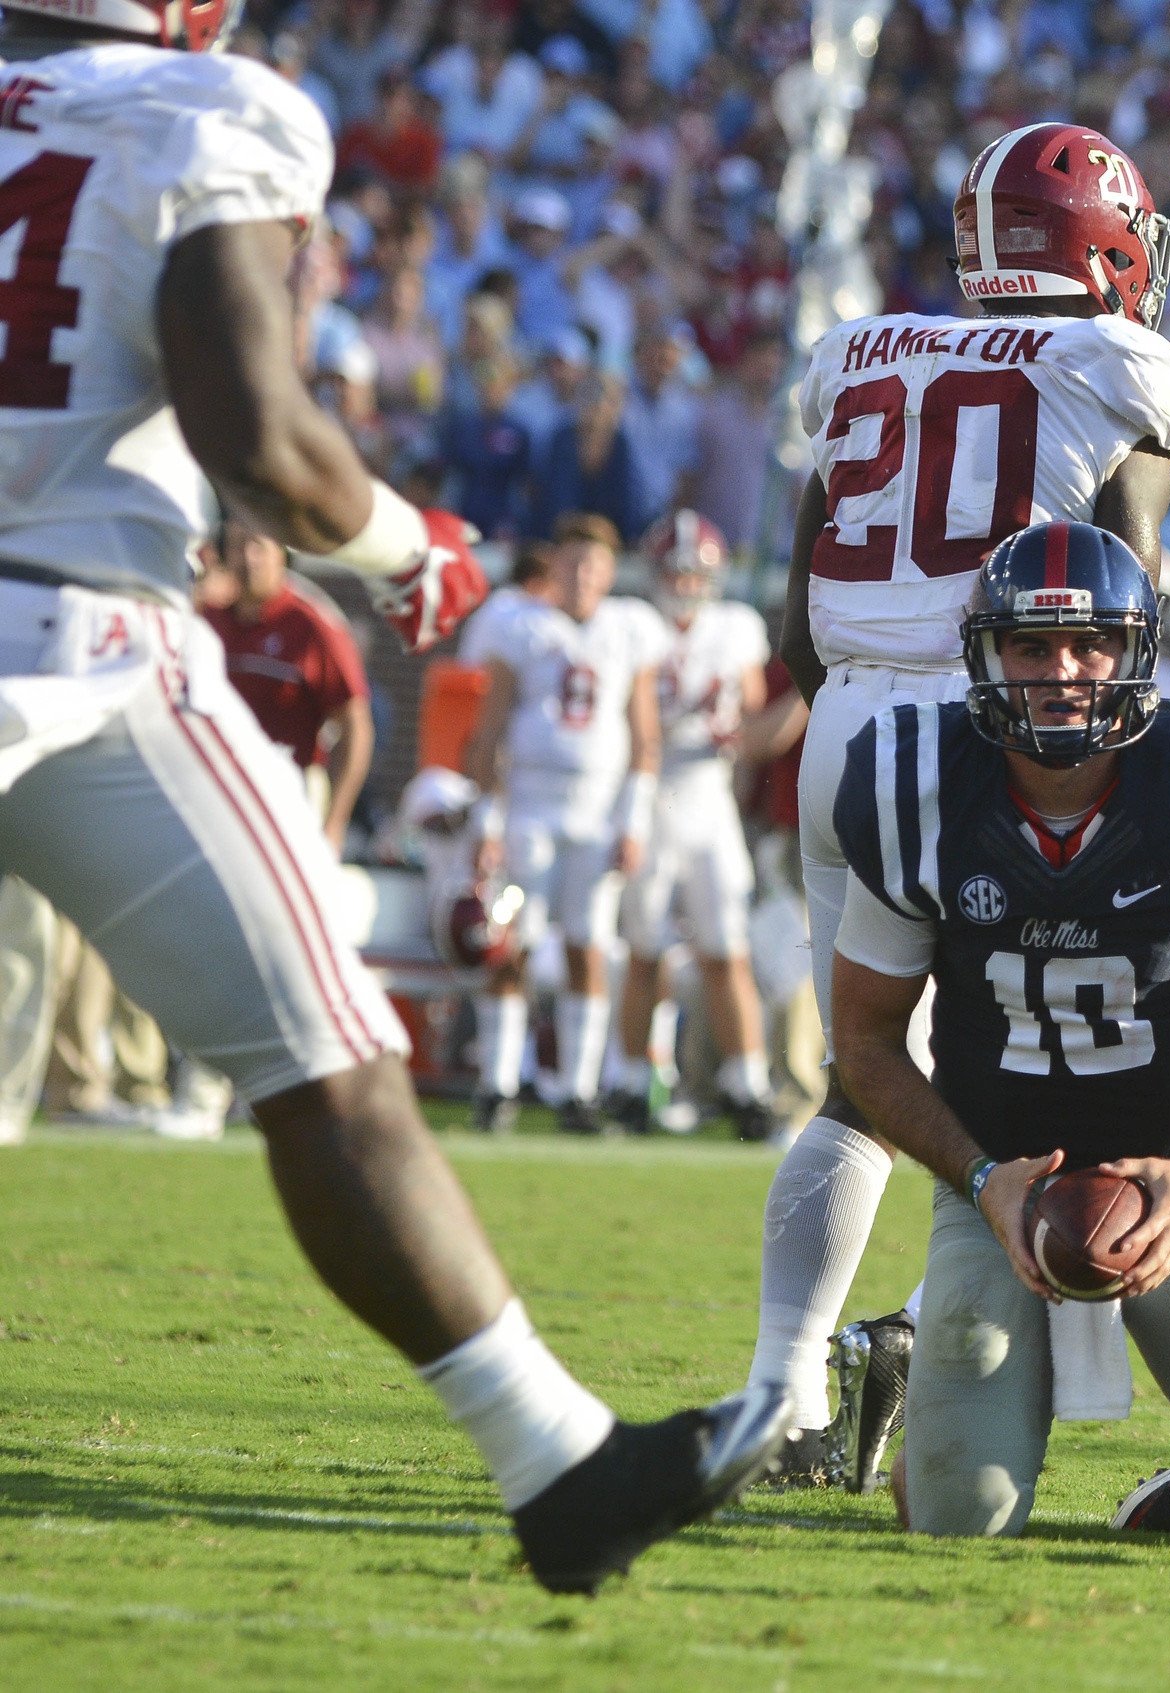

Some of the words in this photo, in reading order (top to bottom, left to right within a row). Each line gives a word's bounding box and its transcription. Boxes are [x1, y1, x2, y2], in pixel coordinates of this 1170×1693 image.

[0, 76, 56, 133] E
[1088, 149, 1138, 221] 20
[962, 275, 1038, 298] Riddell
[842, 327, 1054, 374] HAMILTON
[809, 368, 1039, 582] 20
[1034, 594, 1073, 608] REBS
[962, 879, 1003, 921] SEC
[1020, 918, 1051, 948] Ole
[1052, 919, 1100, 950] Miss
[985, 951, 1156, 1077] 10
